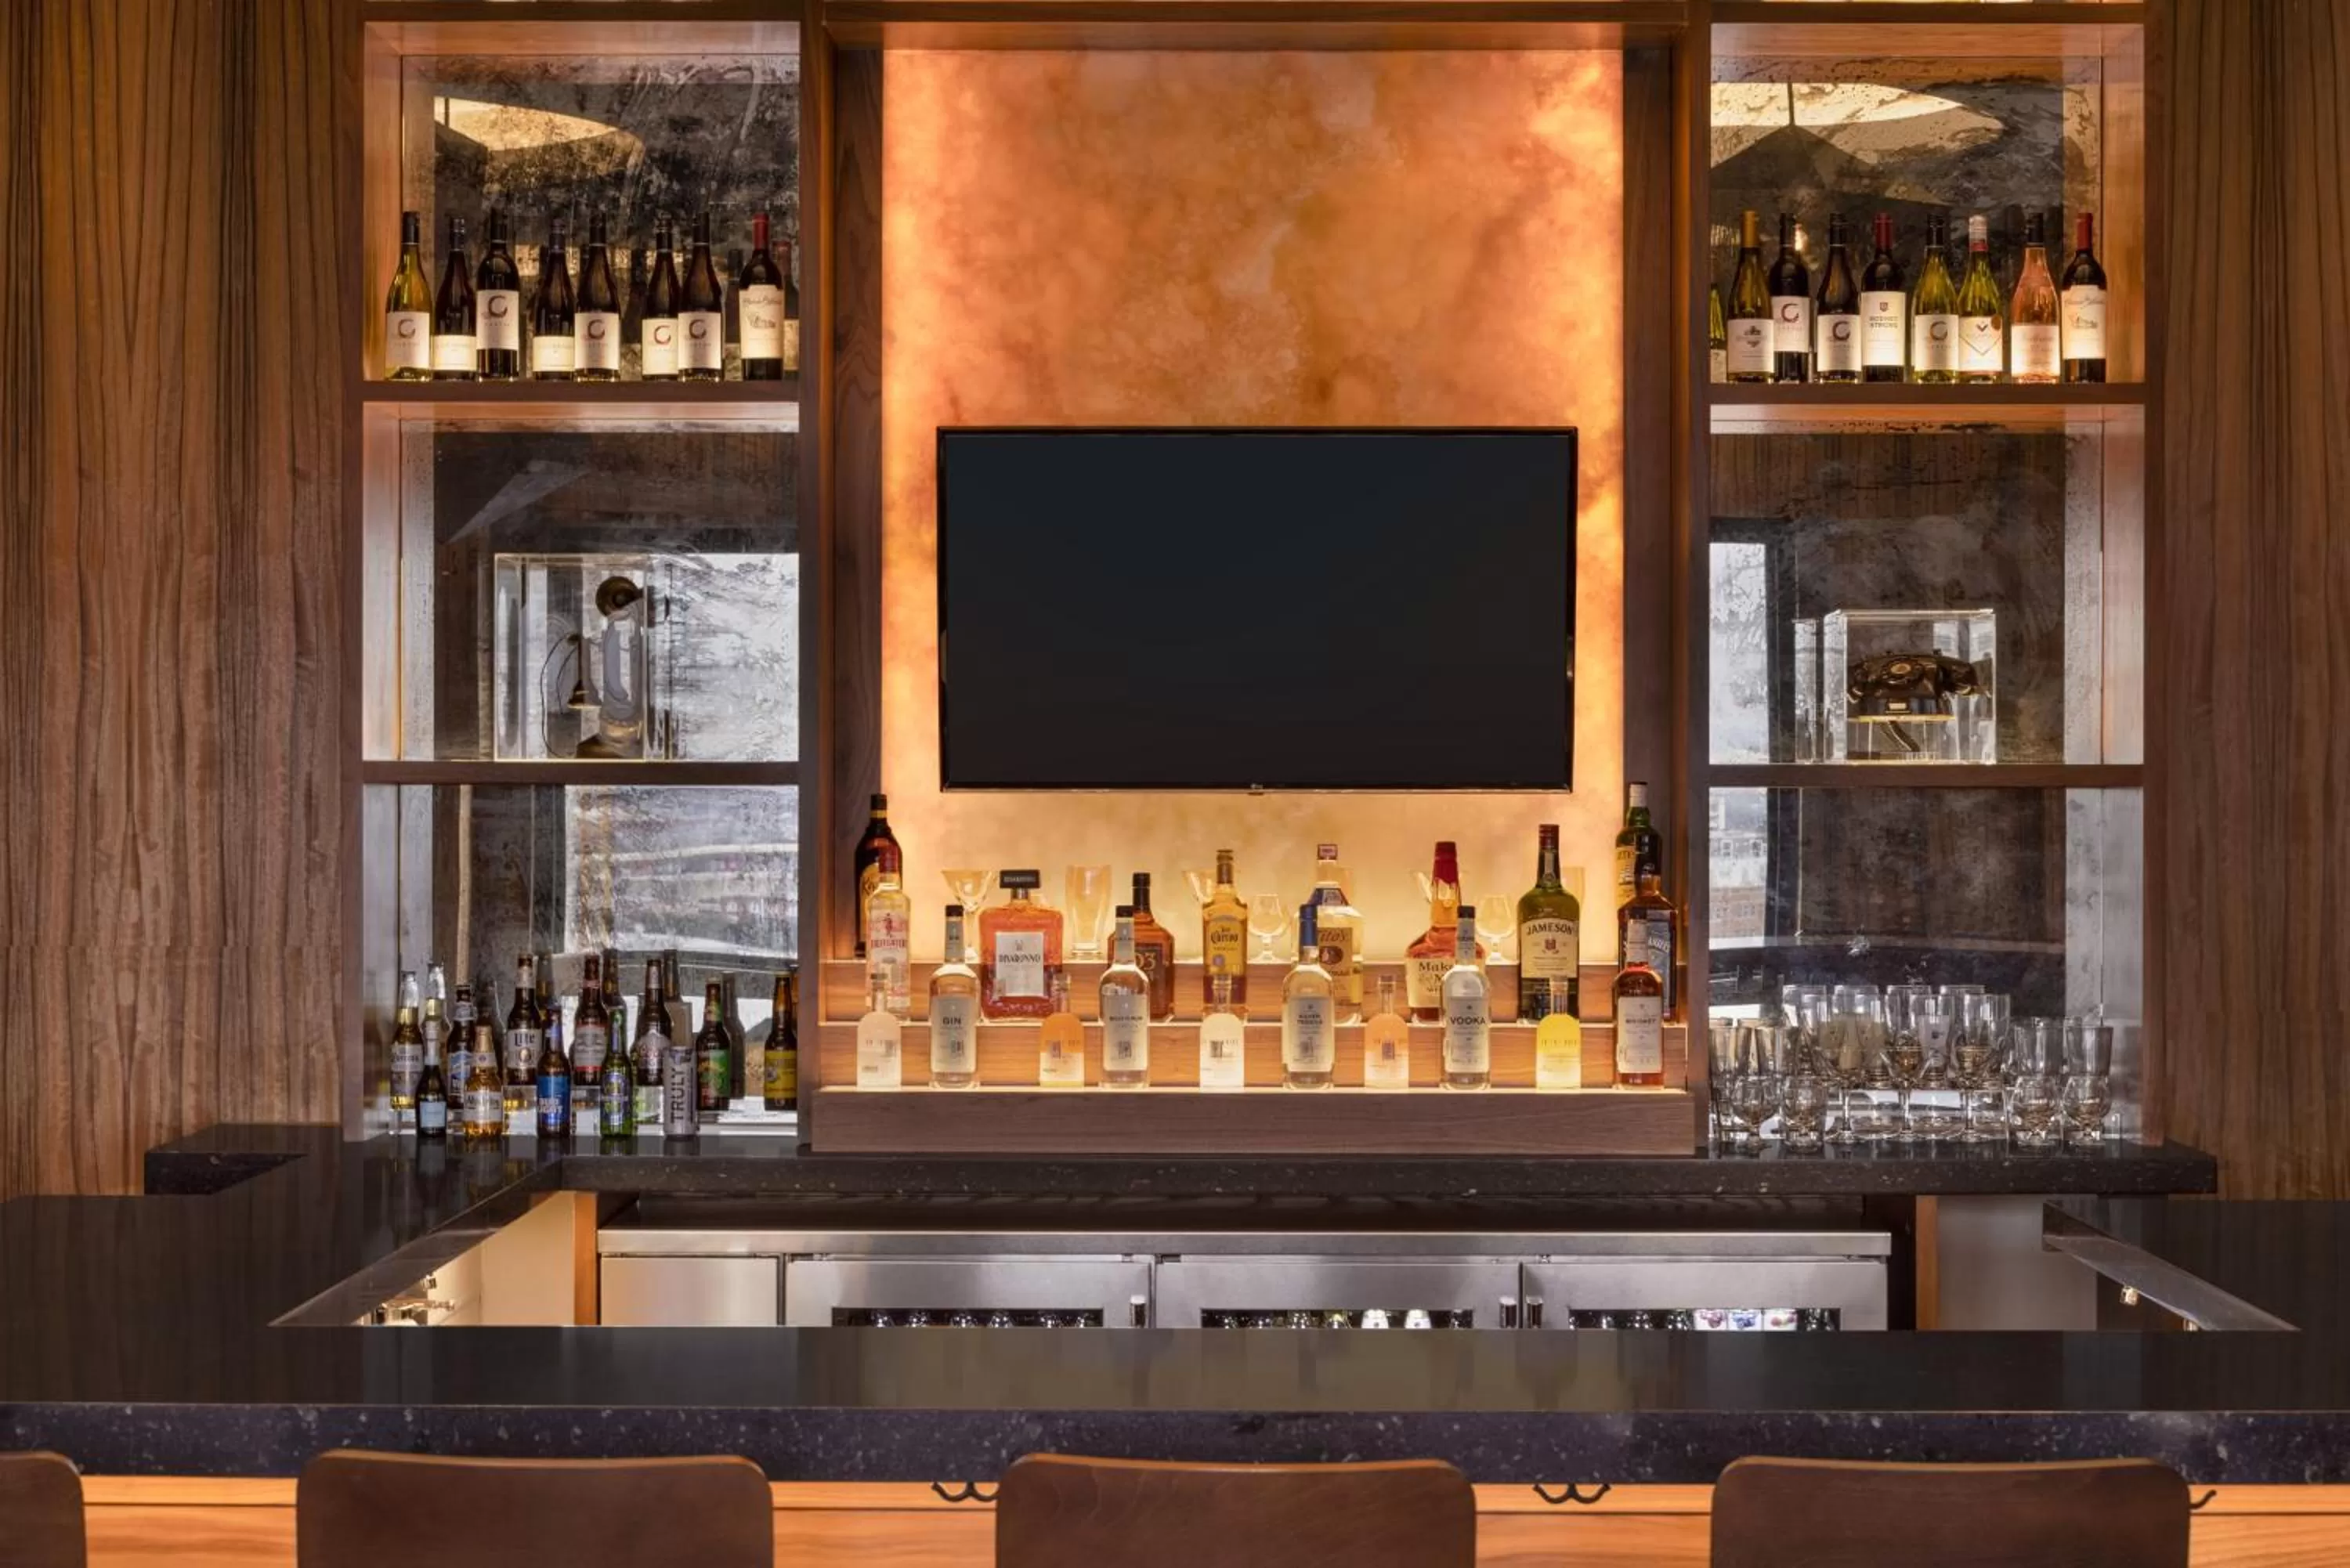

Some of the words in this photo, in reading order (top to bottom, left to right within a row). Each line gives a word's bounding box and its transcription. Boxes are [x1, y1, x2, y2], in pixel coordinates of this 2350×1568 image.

[1526, 922, 1573, 936] JAMESON
[998, 953, 1041, 963] DISARONNO
[1418, 961, 1455, 972] Make
[942, 1017, 962, 1025] GIN
[1449, 1017, 1487, 1026] VODKA
[671, 1068, 685, 1124] TRULY
